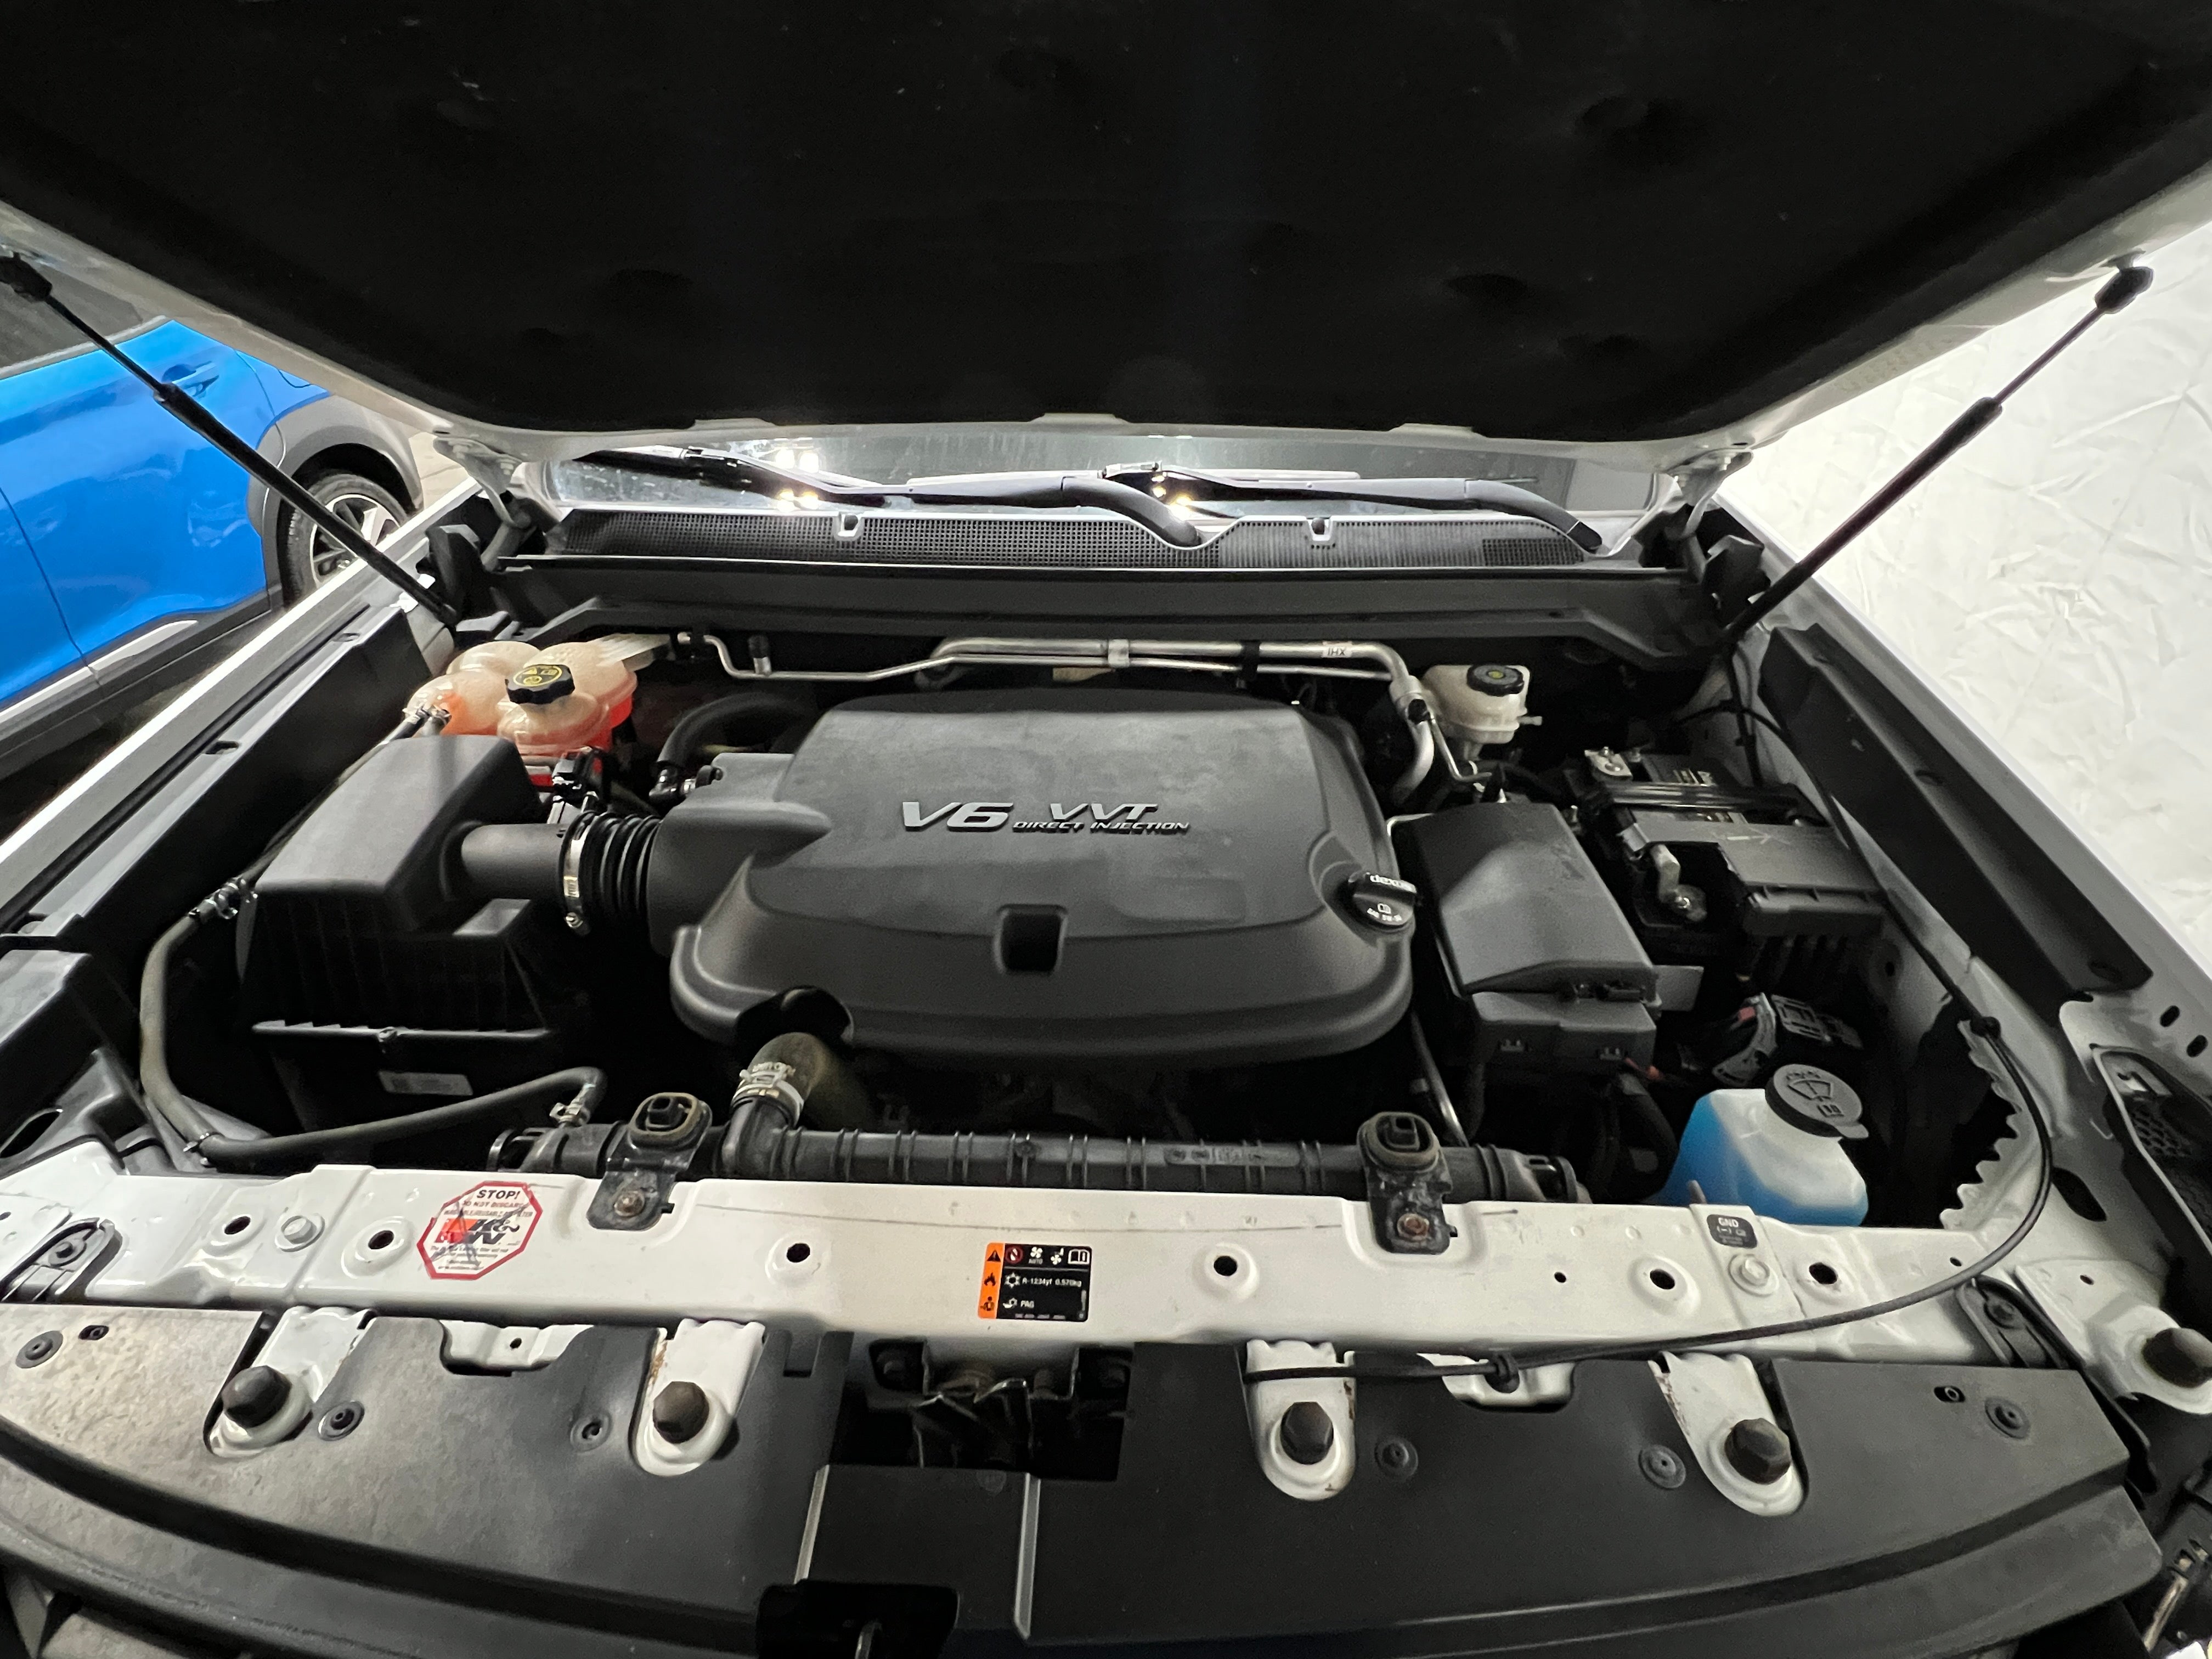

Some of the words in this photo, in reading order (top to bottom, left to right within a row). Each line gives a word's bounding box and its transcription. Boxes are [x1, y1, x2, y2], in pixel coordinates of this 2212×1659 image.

[902, 802, 1014, 832] V6
[1050, 803, 1158, 823] VVT
[1012, 821, 1084, 833] DIRECT
[1090, 822, 1189, 834] INJECTION
[476, 1189, 520, 1200] STOP!
